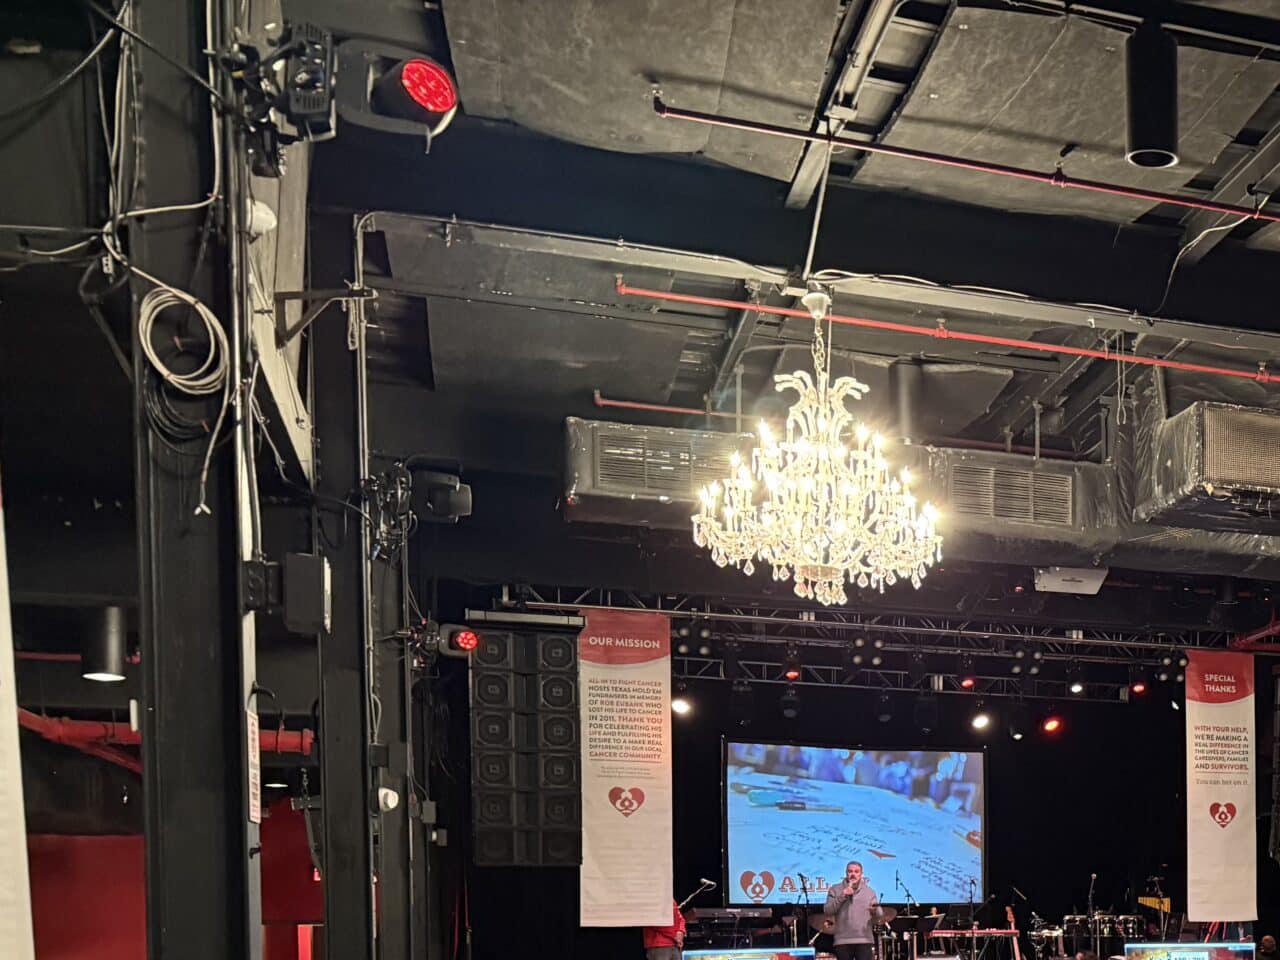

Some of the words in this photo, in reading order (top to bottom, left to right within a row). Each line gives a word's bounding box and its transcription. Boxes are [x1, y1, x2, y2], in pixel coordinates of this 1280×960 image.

[588, 636, 612, 646] OUR
[615, 638, 660, 649] MISSION
[1204, 674, 1236, 683] SPECIAL
[1204, 684, 1237, 693] THANKS
[604, 723, 650, 732] CELEBRATING
